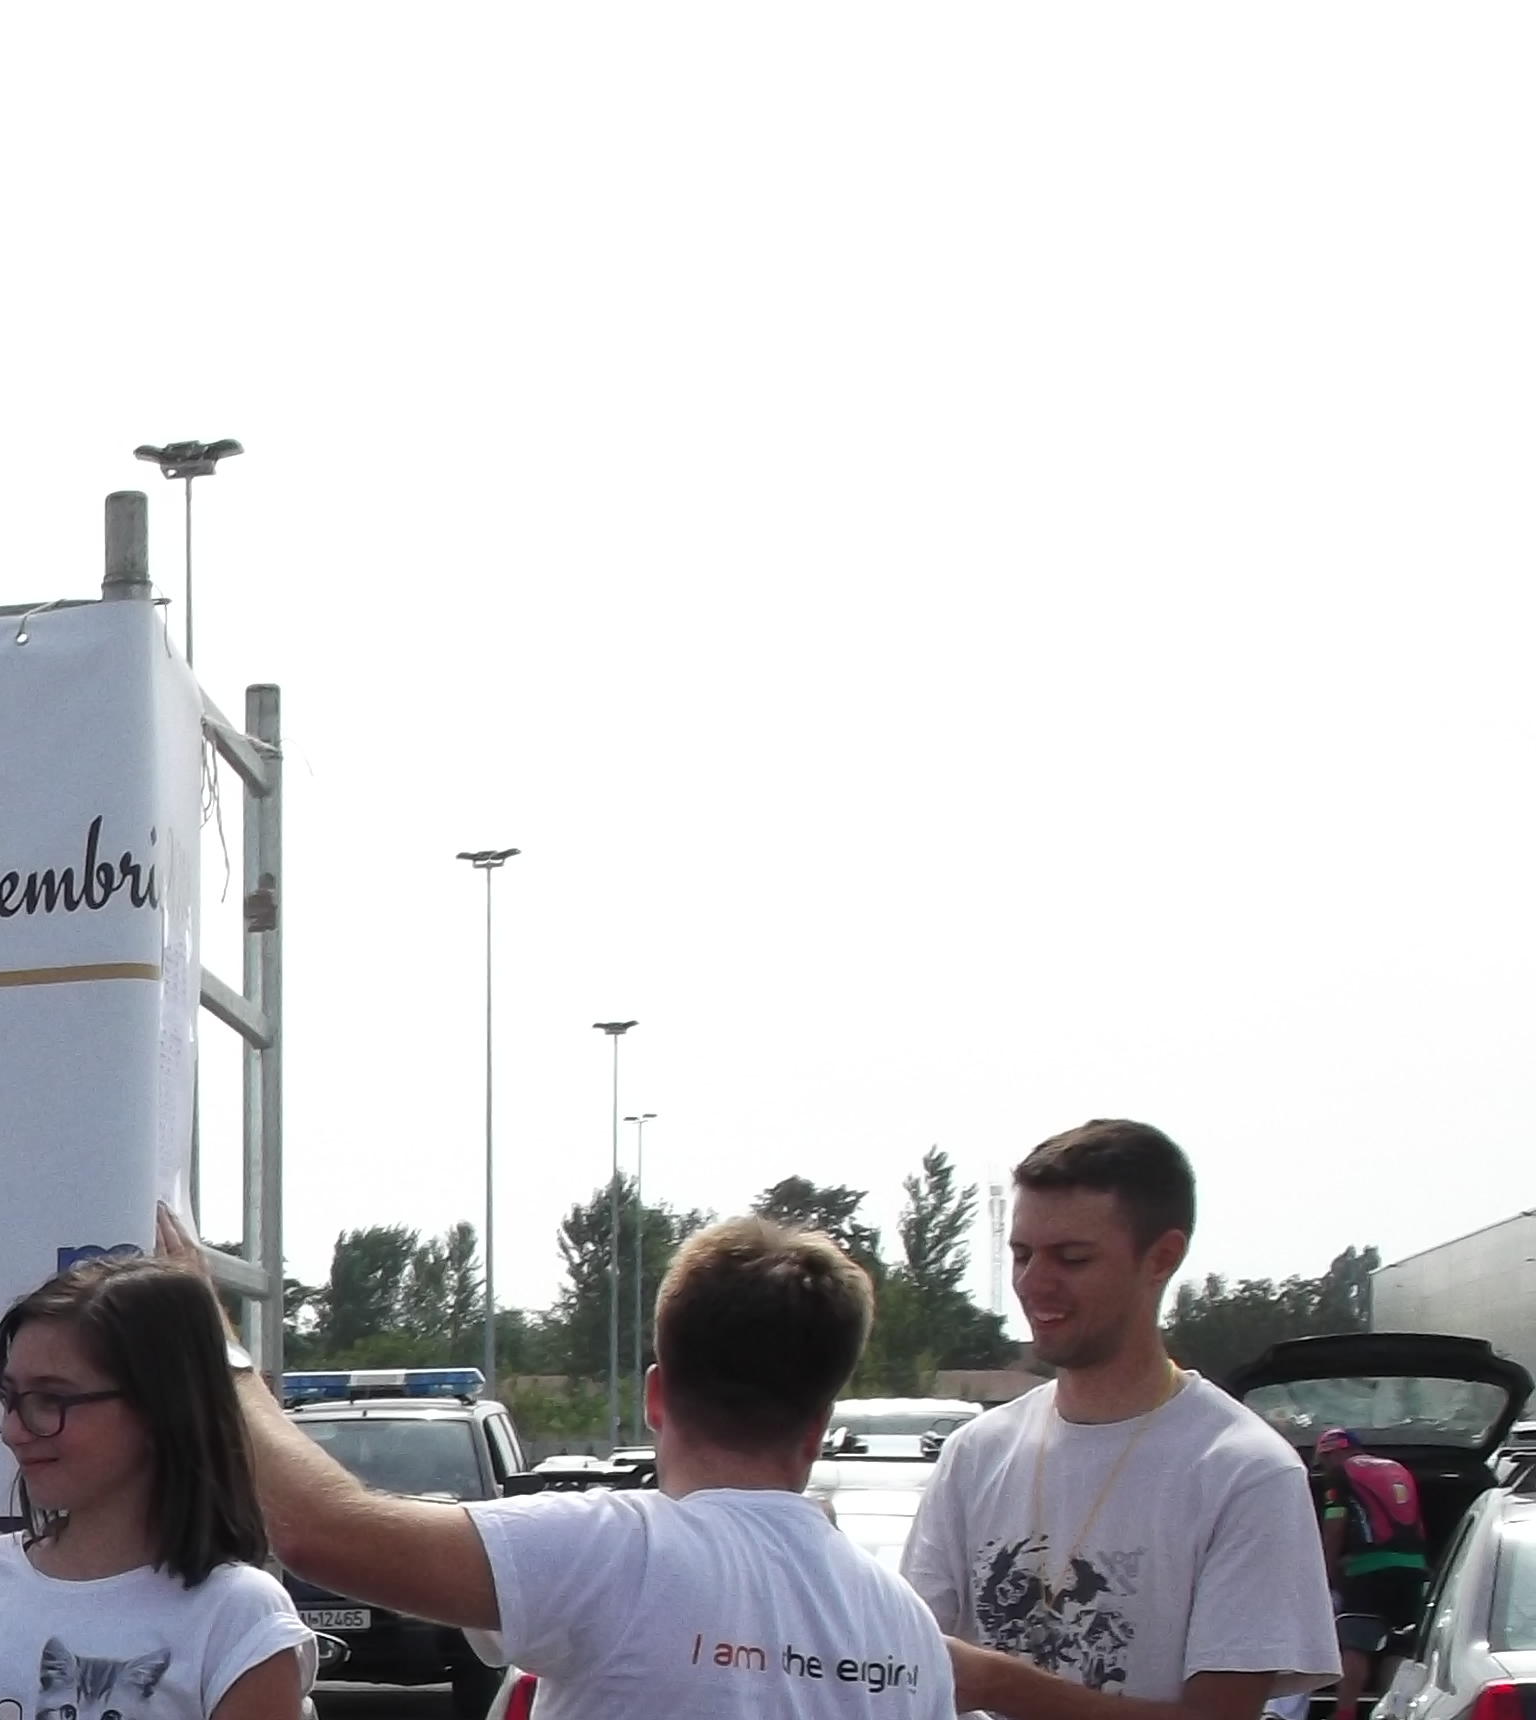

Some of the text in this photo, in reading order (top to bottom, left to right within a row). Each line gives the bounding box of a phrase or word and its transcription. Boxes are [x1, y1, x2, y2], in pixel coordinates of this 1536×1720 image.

[299, 1609, 364, 1630] I-12465
[690, 1634, 703, 1665] I
[713, 1643, 767, 1671] am
[781, 1643, 824, 1679] the
